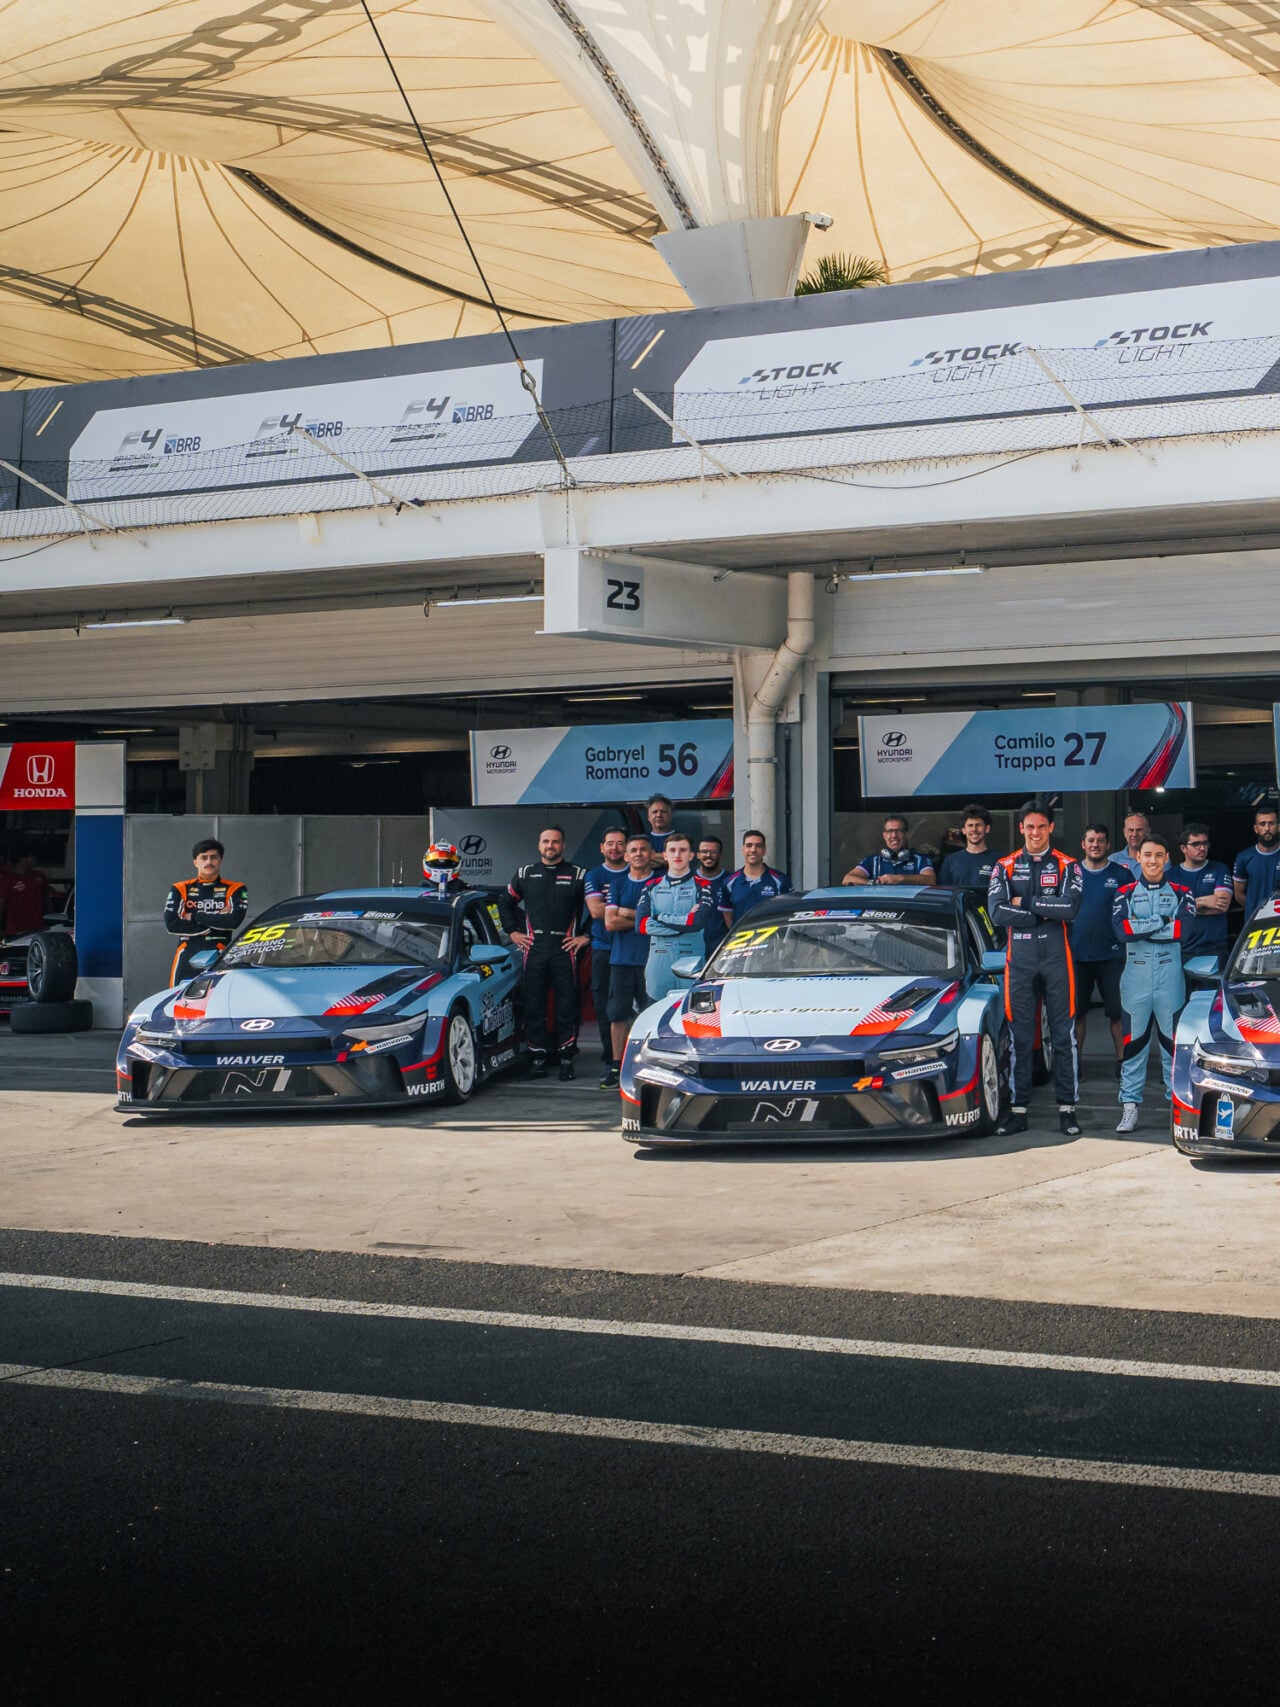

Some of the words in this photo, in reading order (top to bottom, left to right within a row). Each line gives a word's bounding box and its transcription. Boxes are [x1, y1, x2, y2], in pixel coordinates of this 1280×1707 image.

[1108, 321, 1214, 346] STOCK
[924, 342, 1022, 365] STOCK
[1118, 343, 1192, 364] LIGHT
[751, 361, 844, 383] STOCK
[932, 363, 1001, 383] LIGHT
[759, 381, 824, 400] LIGHT
[401, 396, 451, 423] F4
[465, 404, 494, 422] BRB
[317, 421, 343, 438] BRB
[117, 428, 163, 454] F4
[176, 436, 201, 453] BRB
[606, 578, 640, 610] 23
[877, 748, 913, 757] HYUNDAI
[995, 733, 1055, 750] Camilo
[1064, 732, 1107, 766] 27
[585, 745, 645, 764] Gabryel
[658, 742, 699, 777] 56
[995, 753, 1056, 772] Trappa
[586, 764, 650, 780] Romano
[13, 788, 67, 798] HONDA
[460, 858, 492, 867] YUNDAI
[236, 923, 291, 946] 56
[724, 925, 780, 950] 27
[216, 1055, 285, 1066] WAIVER
[407, 1079, 445, 1096] WÜRTH
[741, 1080, 816, 1091] WAIVER
